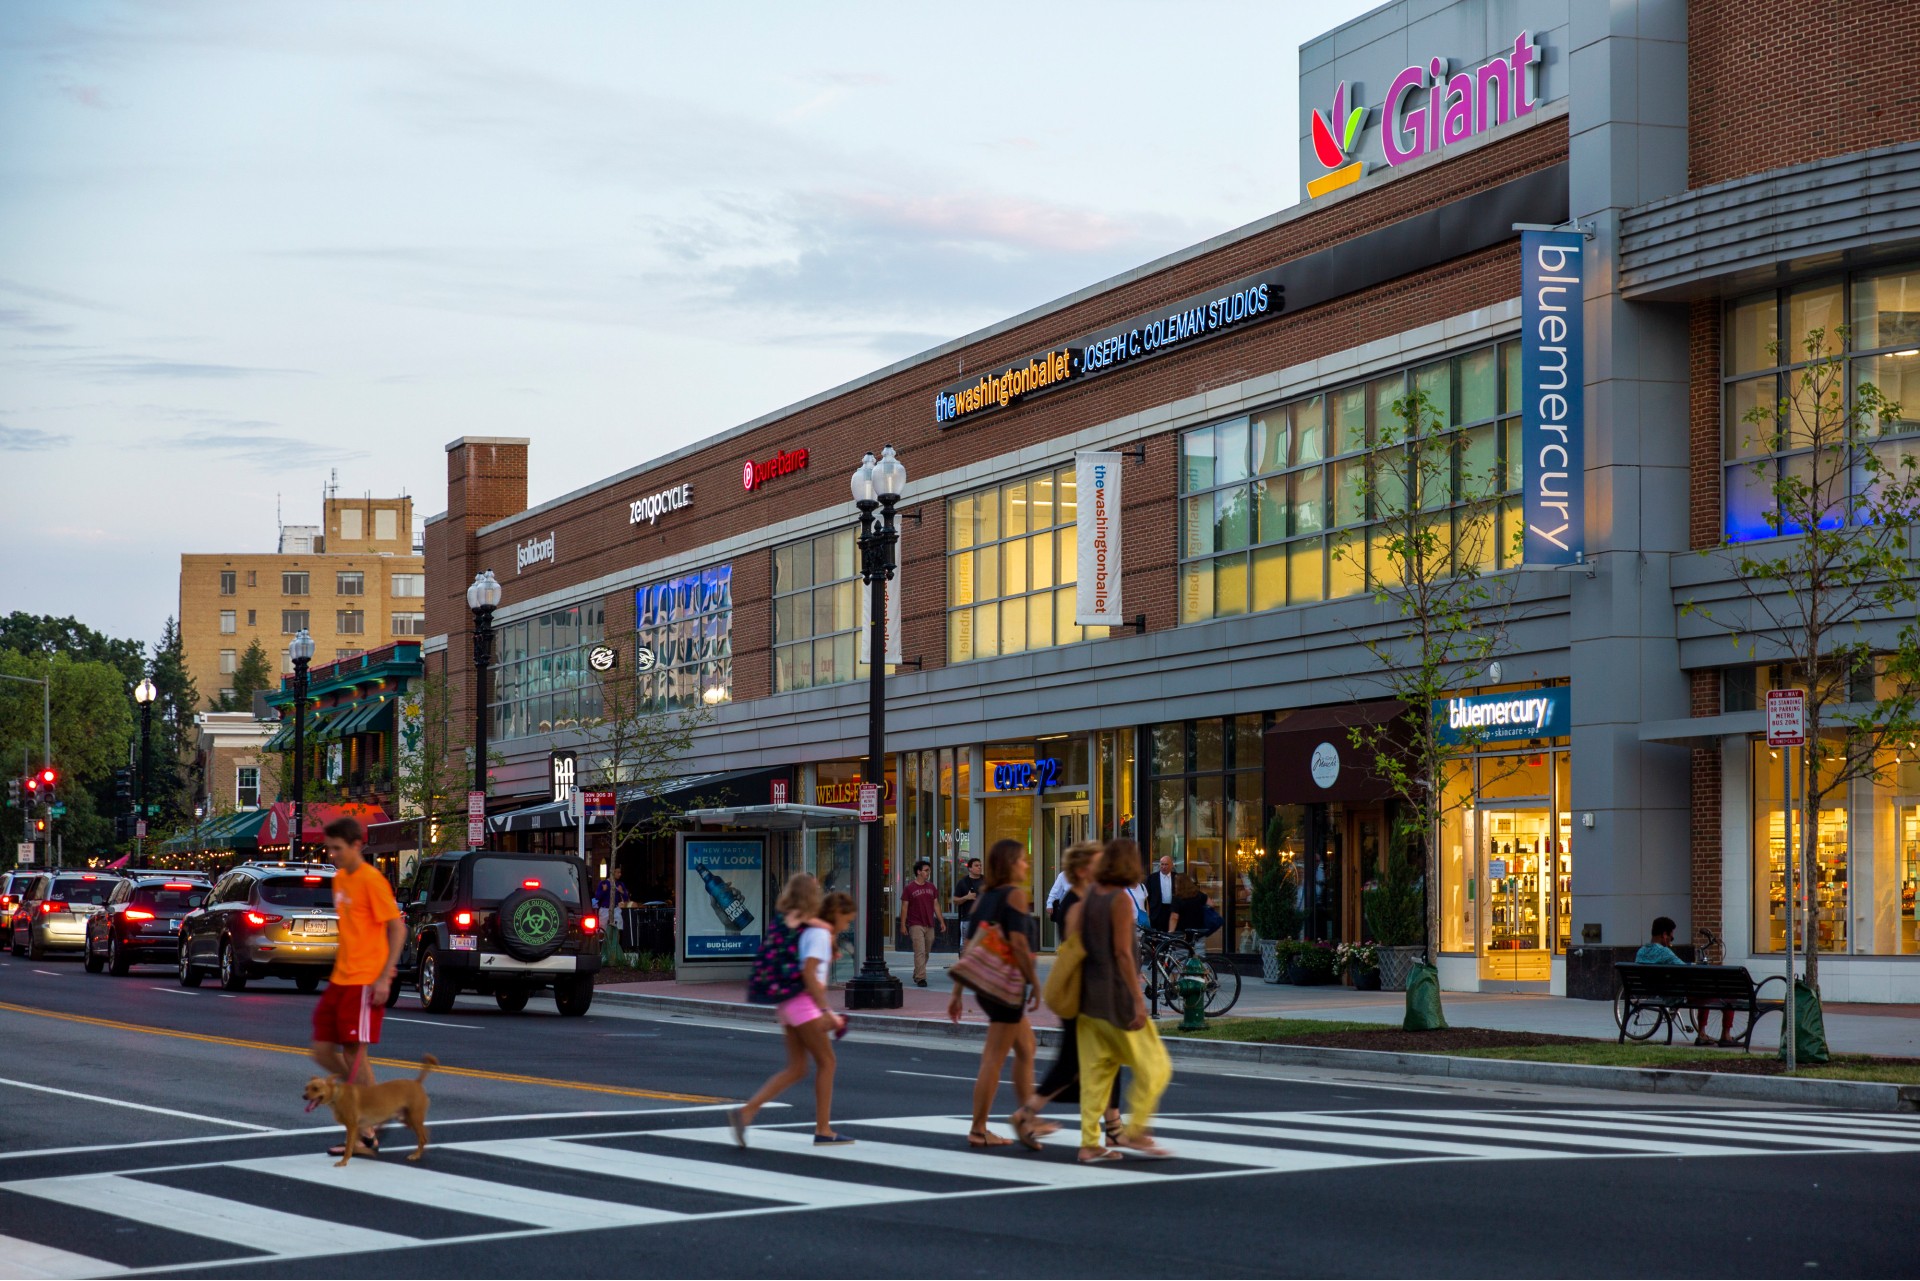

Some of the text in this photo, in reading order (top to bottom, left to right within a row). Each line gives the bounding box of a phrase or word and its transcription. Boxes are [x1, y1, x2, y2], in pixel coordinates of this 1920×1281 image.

[1381, 30, 1536, 167] Giant
[1082, 333, 1127, 373] JOSEPH
[1129, 329, 1140, 355] C.
[1144, 305, 1205, 350] COLEMAN
[1208, 284, 1268, 329] STUDIOS
[1530, 245, 1579, 551] bluemercury
[1450, 698, 1547, 728] bluemercury
[1495, 727, 1523, 737] skincare
[994, 757, 1056, 796] core 72
[816, 784, 851, 804] WELLS
[693, 856, 755, 865] NEW LOOK
[724, 899, 740, 915] BUD
